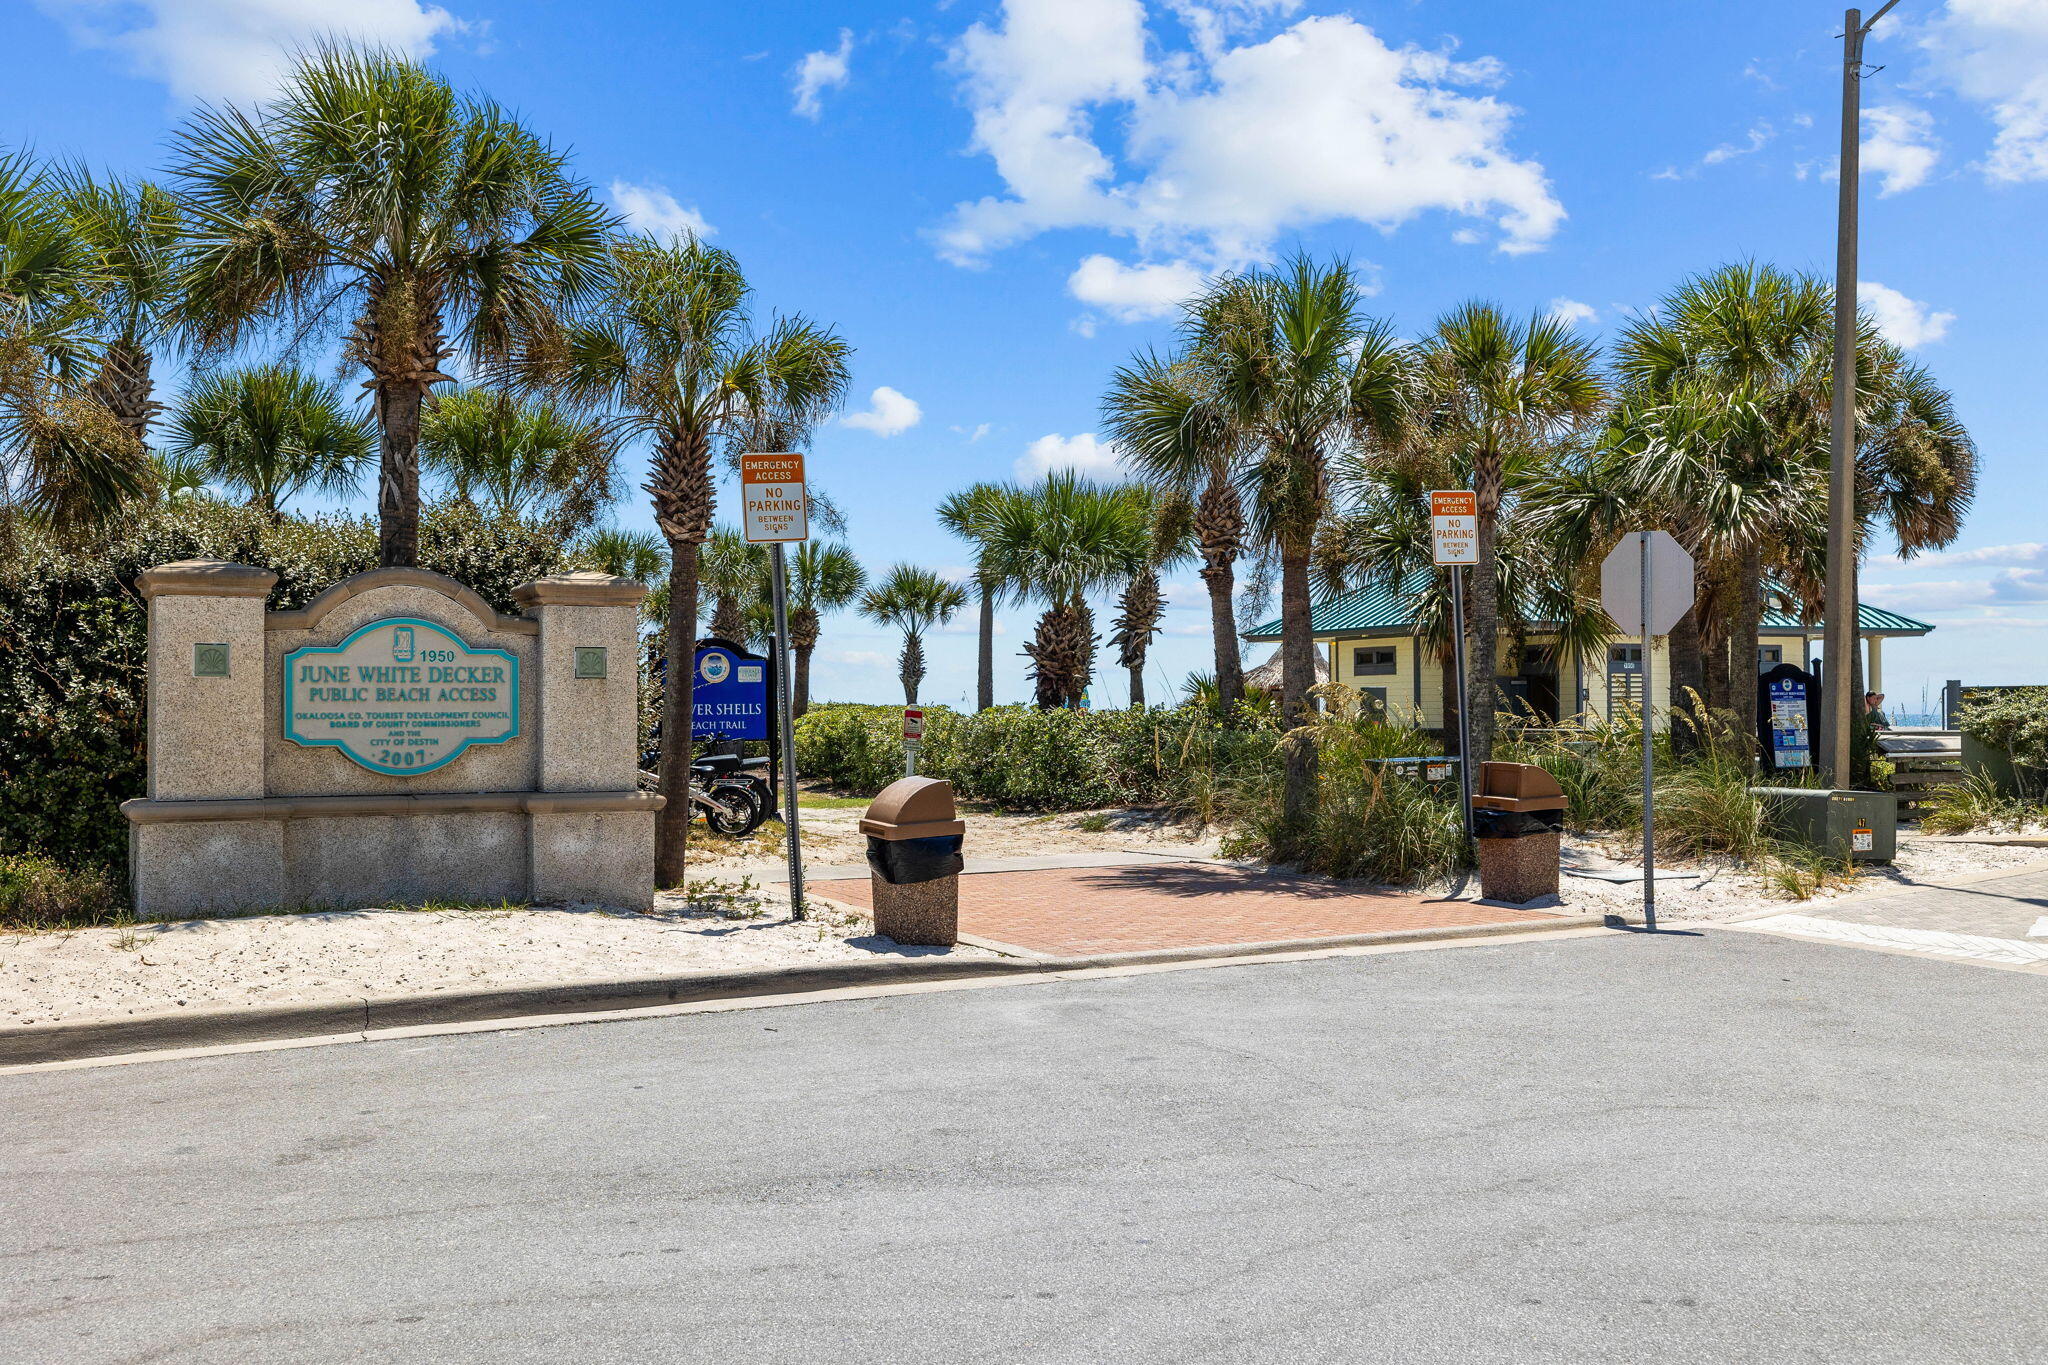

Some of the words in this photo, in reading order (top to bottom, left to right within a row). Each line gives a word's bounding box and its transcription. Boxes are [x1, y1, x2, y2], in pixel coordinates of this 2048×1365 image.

[745, 461, 799, 470] EMERGENCY
[755, 471, 792, 479] ACCESS
[765, 488, 783, 498] NO
[749, 499, 801, 511] PARKING
[1448, 520, 1461, 528] NO
[1436, 530, 1474, 538] PARKING
[420, 650, 455, 663] 1950
[300, 666, 351, 684] JUNE
[358, 666, 422, 684] WHITE
[428, 666, 505, 684] DECKER
[309, 688, 369, 702] PUBLIC
[376, 688, 430, 702] BEACH
[437, 688, 497, 702] ACCESS
[716, 703, 761, 715] SHELLS
[295, 712, 345, 720] OKALOOSA
[349, 712, 364, 720] CO.
[366, 712, 404, 720] TOURIST
[411, 720, 481, 728] COMMISSIONERS
[719, 721, 746, 729] TRAIL
[408, 738, 439, 746] DESTIN
[378, 750, 425, 766] 2007
